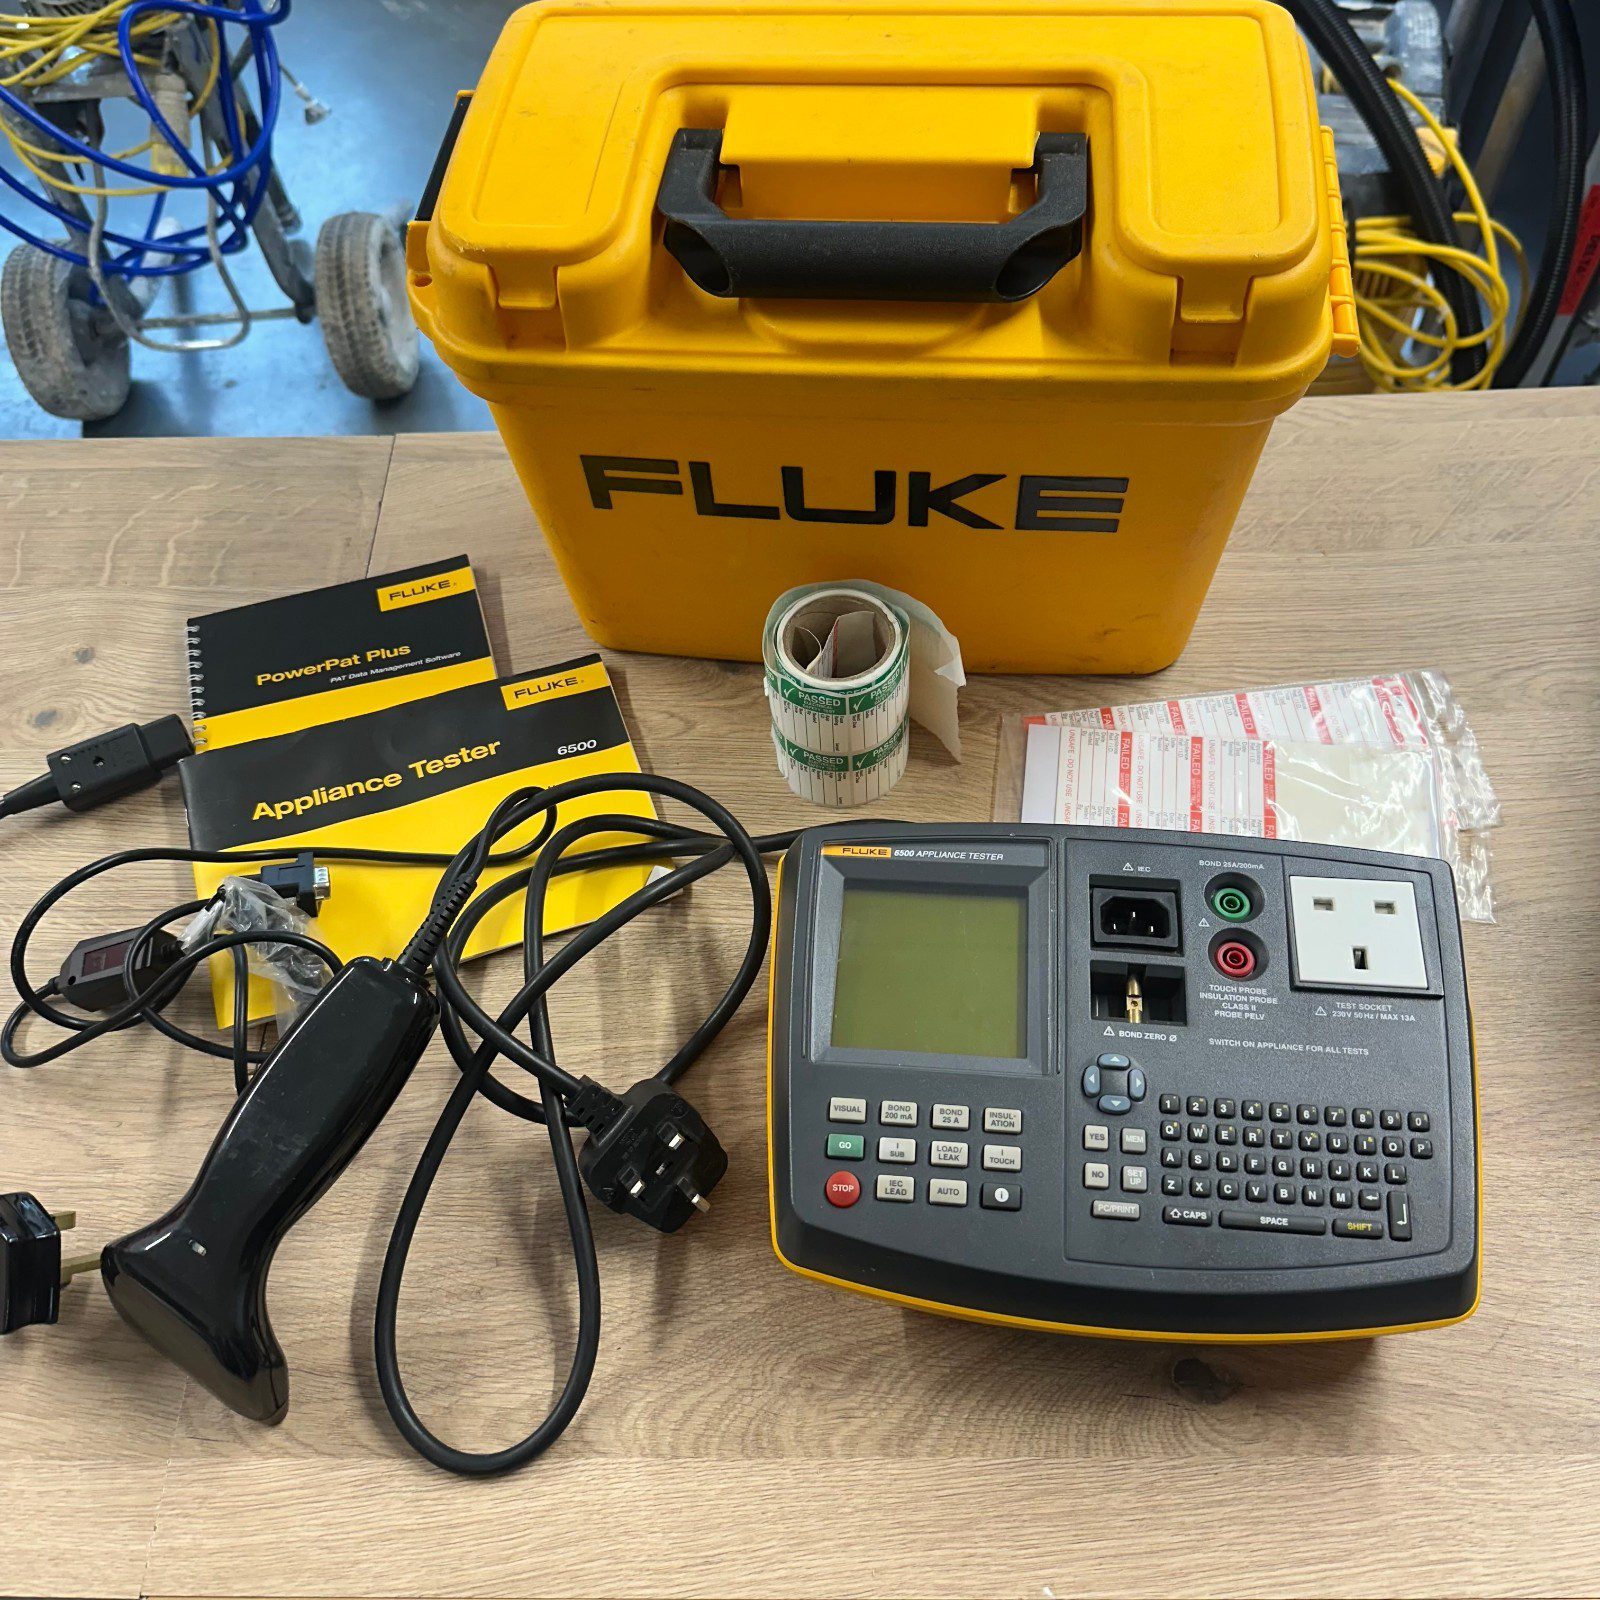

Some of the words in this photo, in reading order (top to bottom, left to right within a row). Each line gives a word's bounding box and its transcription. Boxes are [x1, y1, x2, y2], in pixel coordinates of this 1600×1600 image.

[580, 454, 1129, 532] FLUKE
[389, 580, 451, 601] FLUKE
[256, 652, 361, 686] PowerPat
[366, 643, 411, 662] Plus
[330, 675, 348, 684] PAT
[349, 672, 368, 681] Data
[370, 659, 424, 678] Management
[425, 651, 461, 665] Software
[514, 676, 578, 699] FLUKE
[798, 692, 840, 706] PASSED
[1240, 699, 1254, 730] FAILED
[1171, 706, 1184, 734] FAILE
[557, 739, 597, 756] 6500
[803, 751, 844, 764] PASSED
[1121, 738, 1130, 770] FAILED
[1192, 744, 1200, 775] FAILED
[1264, 748, 1274, 780] FAILED
[252, 773, 402, 821] Appliance
[408, 740, 501, 779] Tester
[842, 847, 888, 856] FLUKE
[916, 850, 966, 860] APPLIANCE
[969, 852, 1003, 860] TESTER
[1199, 860, 1221, 868] BOND
[1223, 861, 1264, 870] 25A/200mA
[1209, 984, 1236, 994] TOUCH
[1238, 987, 1267, 995] PROBE
[1200, 992, 1248, 1003] INSULATION
[1250, 996, 1278, 1004] PROBE
[1222, 1002, 1247, 1011] CLASS
[1358, 1003, 1392, 1012] SOCKET
[1214, 1010, 1242, 1019] PROBE
[1244, 1012, 1265, 1020] PELV
[1119, 1030, 1142, 1039] BOND
[1144, 1032, 1167, 1040] ZERO
[1209, 1038, 1241, 1047] SWITCH
[1256, 1042, 1303, 1051] APPLIANCE
[1342, 1047, 1369, 1055] TESTS
[1165, 1100, 1171, 1108] 1
[1192, 1102, 1200, 1111] 2
[1220, 1104, 1226, 1112] 3
[1248, 1106, 1255, 1115] 4
[1276, 1108, 1282, 1117] 5
[1303, 1110, 1310, 1119] 6
[1331, 1112, 1338, 1121] 7
[1359, 1114, 1366, 1123] 8
[1387, 1116, 1394, 1124] 9
[991, 1120, 1015, 1128] ATION
[1415, 1117, 1422, 1126] 0
[1165, 1125, 1174, 1135] Q
[1193, 1128, 1203, 1137] W
[1089, 1132, 1105, 1141] YES
[1125, 1135, 1144, 1144] MEM
[1221, 1130, 1229, 1140] E
[1249, 1132, 1257, 1141] R
[1277, 1135, 1284, 1143] T
[1305, 1136, 1312, 1145] Y
[1333, 1138, 1340, 1147] U
[1363, 1141, 1367, 1149] I
[936, 1145, 962, 1153] LOAD/
[1389, 1142, 1398, 1152] O
[1417, 1144, 1425, 1153] P
[990, 1157, 1015, 1165] TOUCH
[1166, 1153, 1174, 1162] A
[1194, 1155, 1202, 1164] S
[1223, 1157, 1230, 1166] D
[1251, 1159, 1258, 1168] F
[1278, 1161, 1286, 1170] G
[1307, 1163, 1314, 1172] H
[1091, 1170, 1104, 1179] NO
[1127, 1169, 1142, 1178] SET
[1336, 1166, 1342, 1175] J
[1364, 1168, 1371, 1176] K
[1392, 1170, 1399, 1179] L
[1130, 1178, 1140, 1186] UP
[1168, 1180, 1175, 1189] Z
[1196, 1182, 1203, 1191] X
[1224, 1184, 1232, 1194] C
[1252, 1187, 1260, 1196] V
[1280, 1189, 1288, 1198] B
[1309, 1191, 1316, 1200] N
[1337, 1193, 1346, 1202] M
[1098, 1204, 1135, 1214] PC/PRINT
[1183, 1210, 1207, 1220] CAPS
[1260, 1216, 1288, 1226] SPACE
[1347, 1222, 1372, 1232] SHIFT
